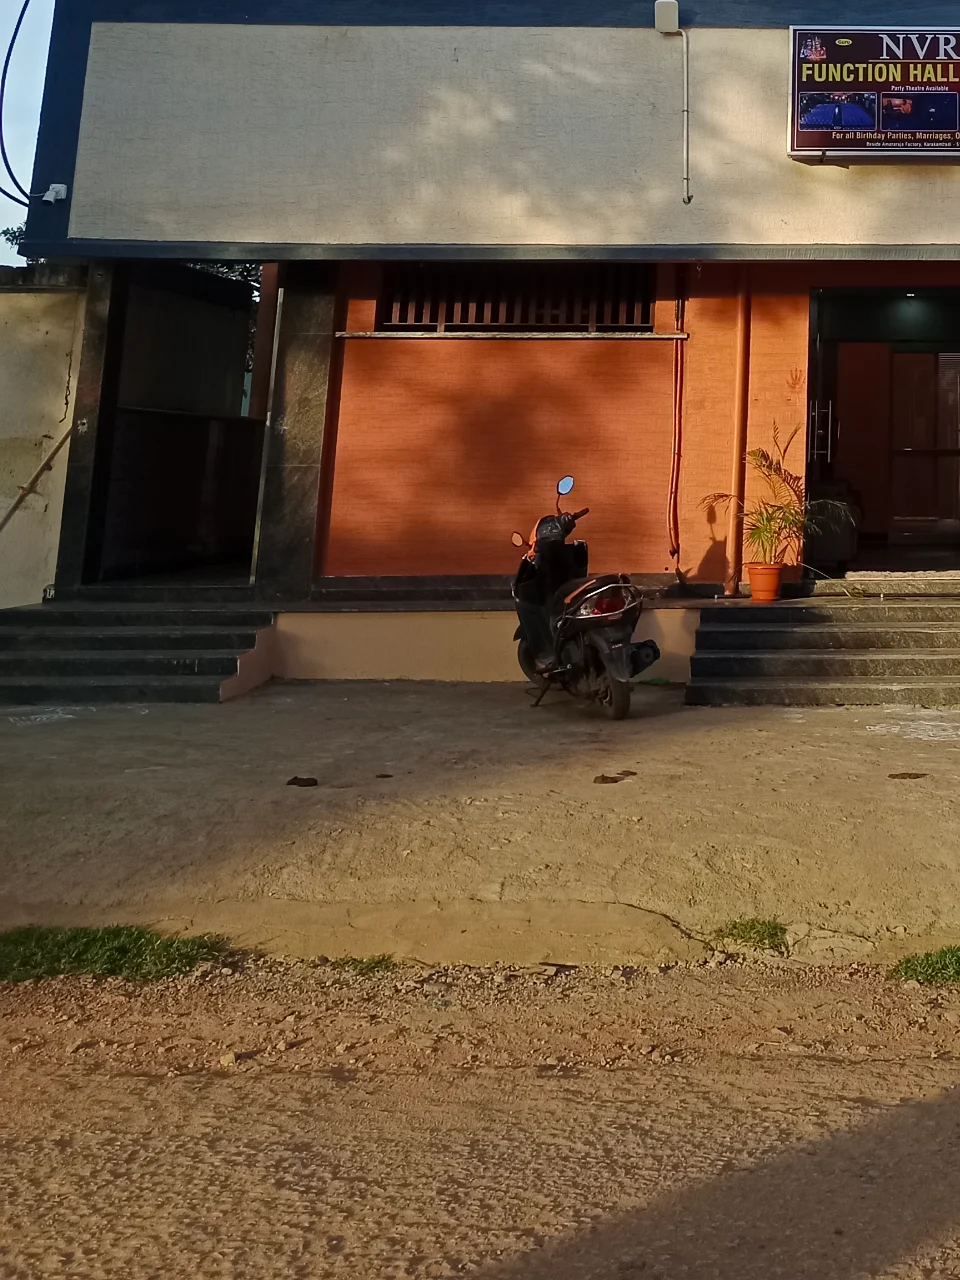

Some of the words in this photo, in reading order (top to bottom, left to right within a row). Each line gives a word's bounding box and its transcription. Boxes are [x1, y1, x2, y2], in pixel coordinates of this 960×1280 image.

[878, 34, 960, 60] NVR
[801, 63, 901, 82] FUNCTION
[909, 63, 960, 82] HALL
[856, 132, 885, 141] Birthday
[887, 132, 914, 140] Parties,
[916, 132, 954, 141] Marriages,
